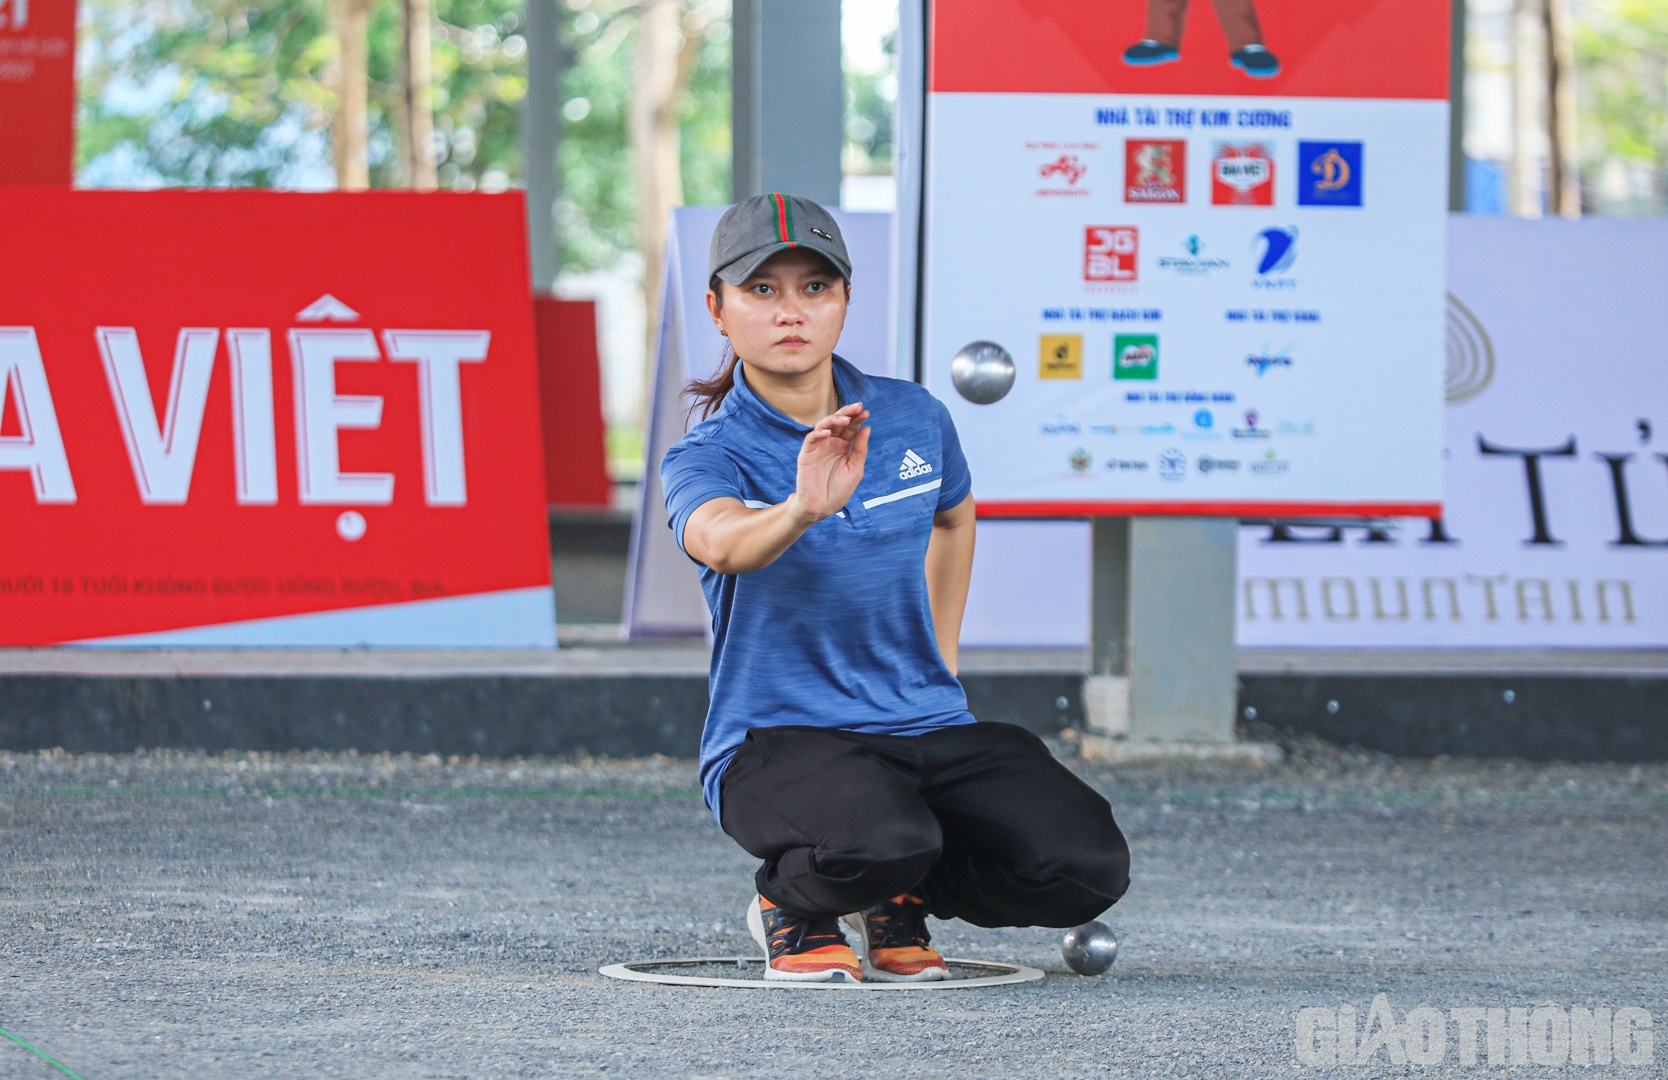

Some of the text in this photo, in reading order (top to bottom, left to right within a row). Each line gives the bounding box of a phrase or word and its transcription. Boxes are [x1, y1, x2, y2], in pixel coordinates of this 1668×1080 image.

[1201, 109, 1231, 126] KIM
[95, 293, 492, 541] VIỆT
[899, 463, 933, 480] adidas
